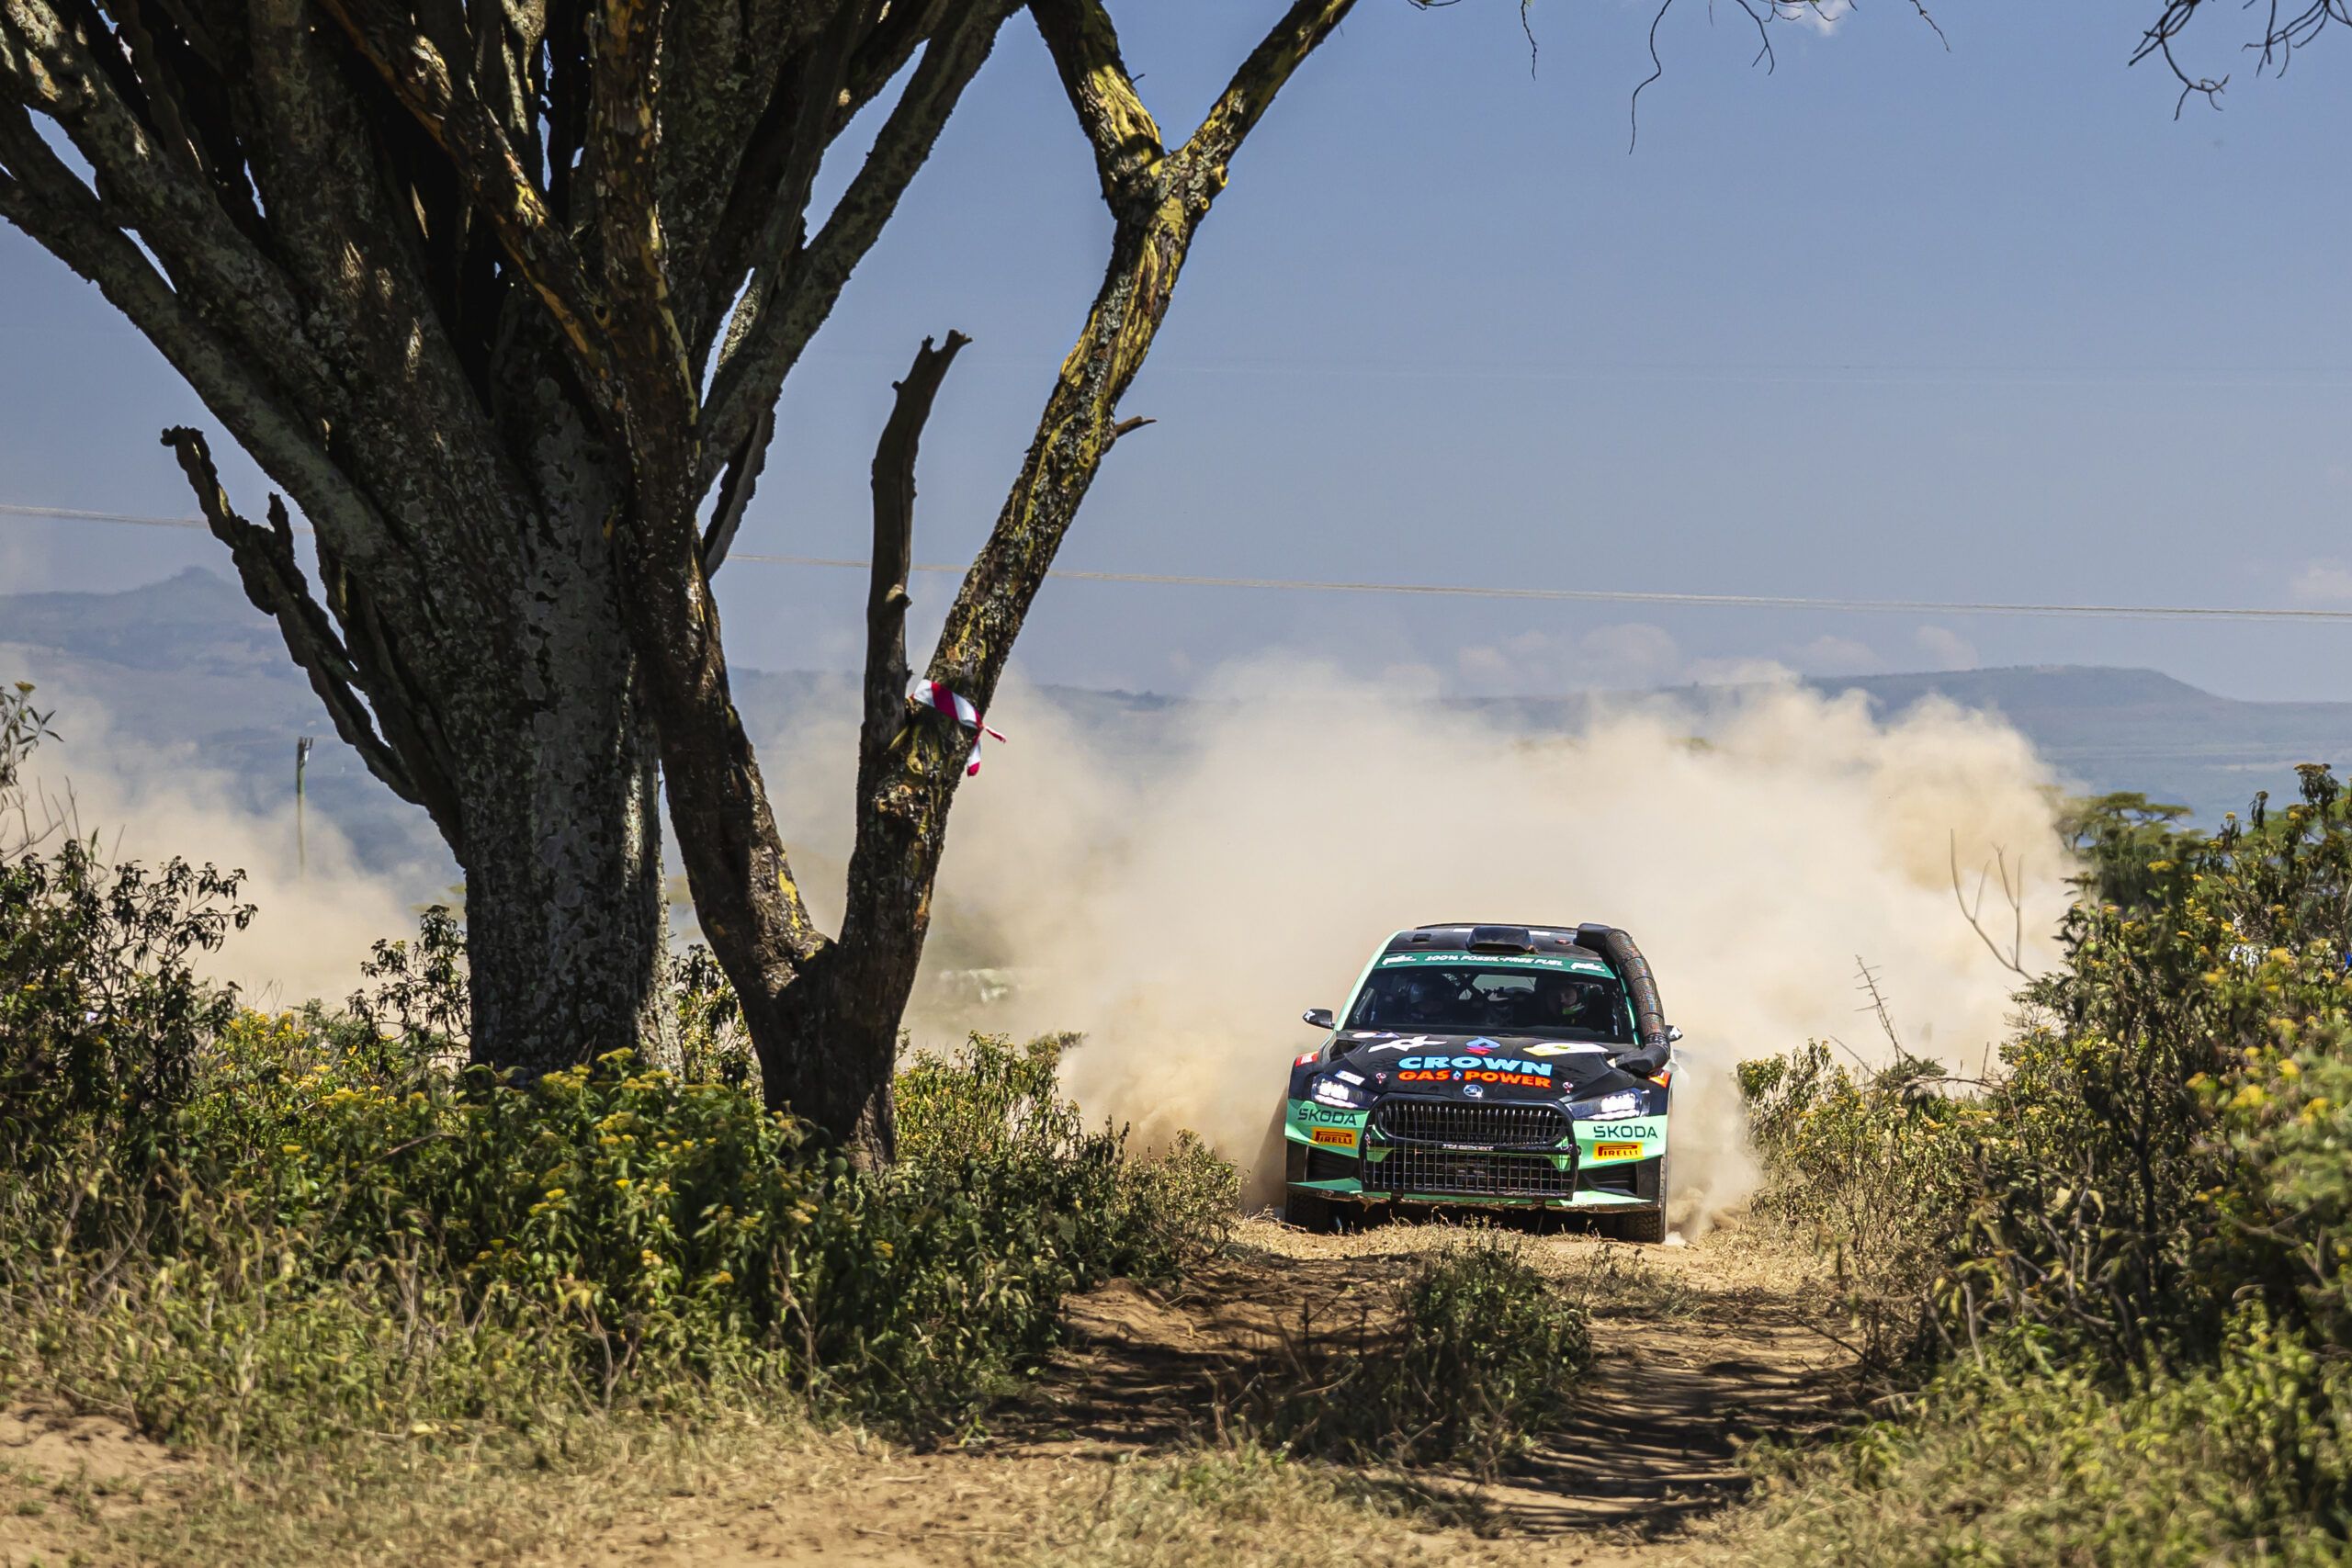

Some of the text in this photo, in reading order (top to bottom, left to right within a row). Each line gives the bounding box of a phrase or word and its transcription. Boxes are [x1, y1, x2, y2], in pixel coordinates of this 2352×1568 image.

[1460, 954, 1533, 964] FOSSIL-FREE
[1534, 958, 1564, 966] FUEL
[1398, 1056, 1553, 1077] CROWN
[1397, 1069, 1552, 1089] GAS POWER
[1315, 1131, 1352, 1145] PIRELLI
[1598, 1145, 1638, 1156] PIRELLI
